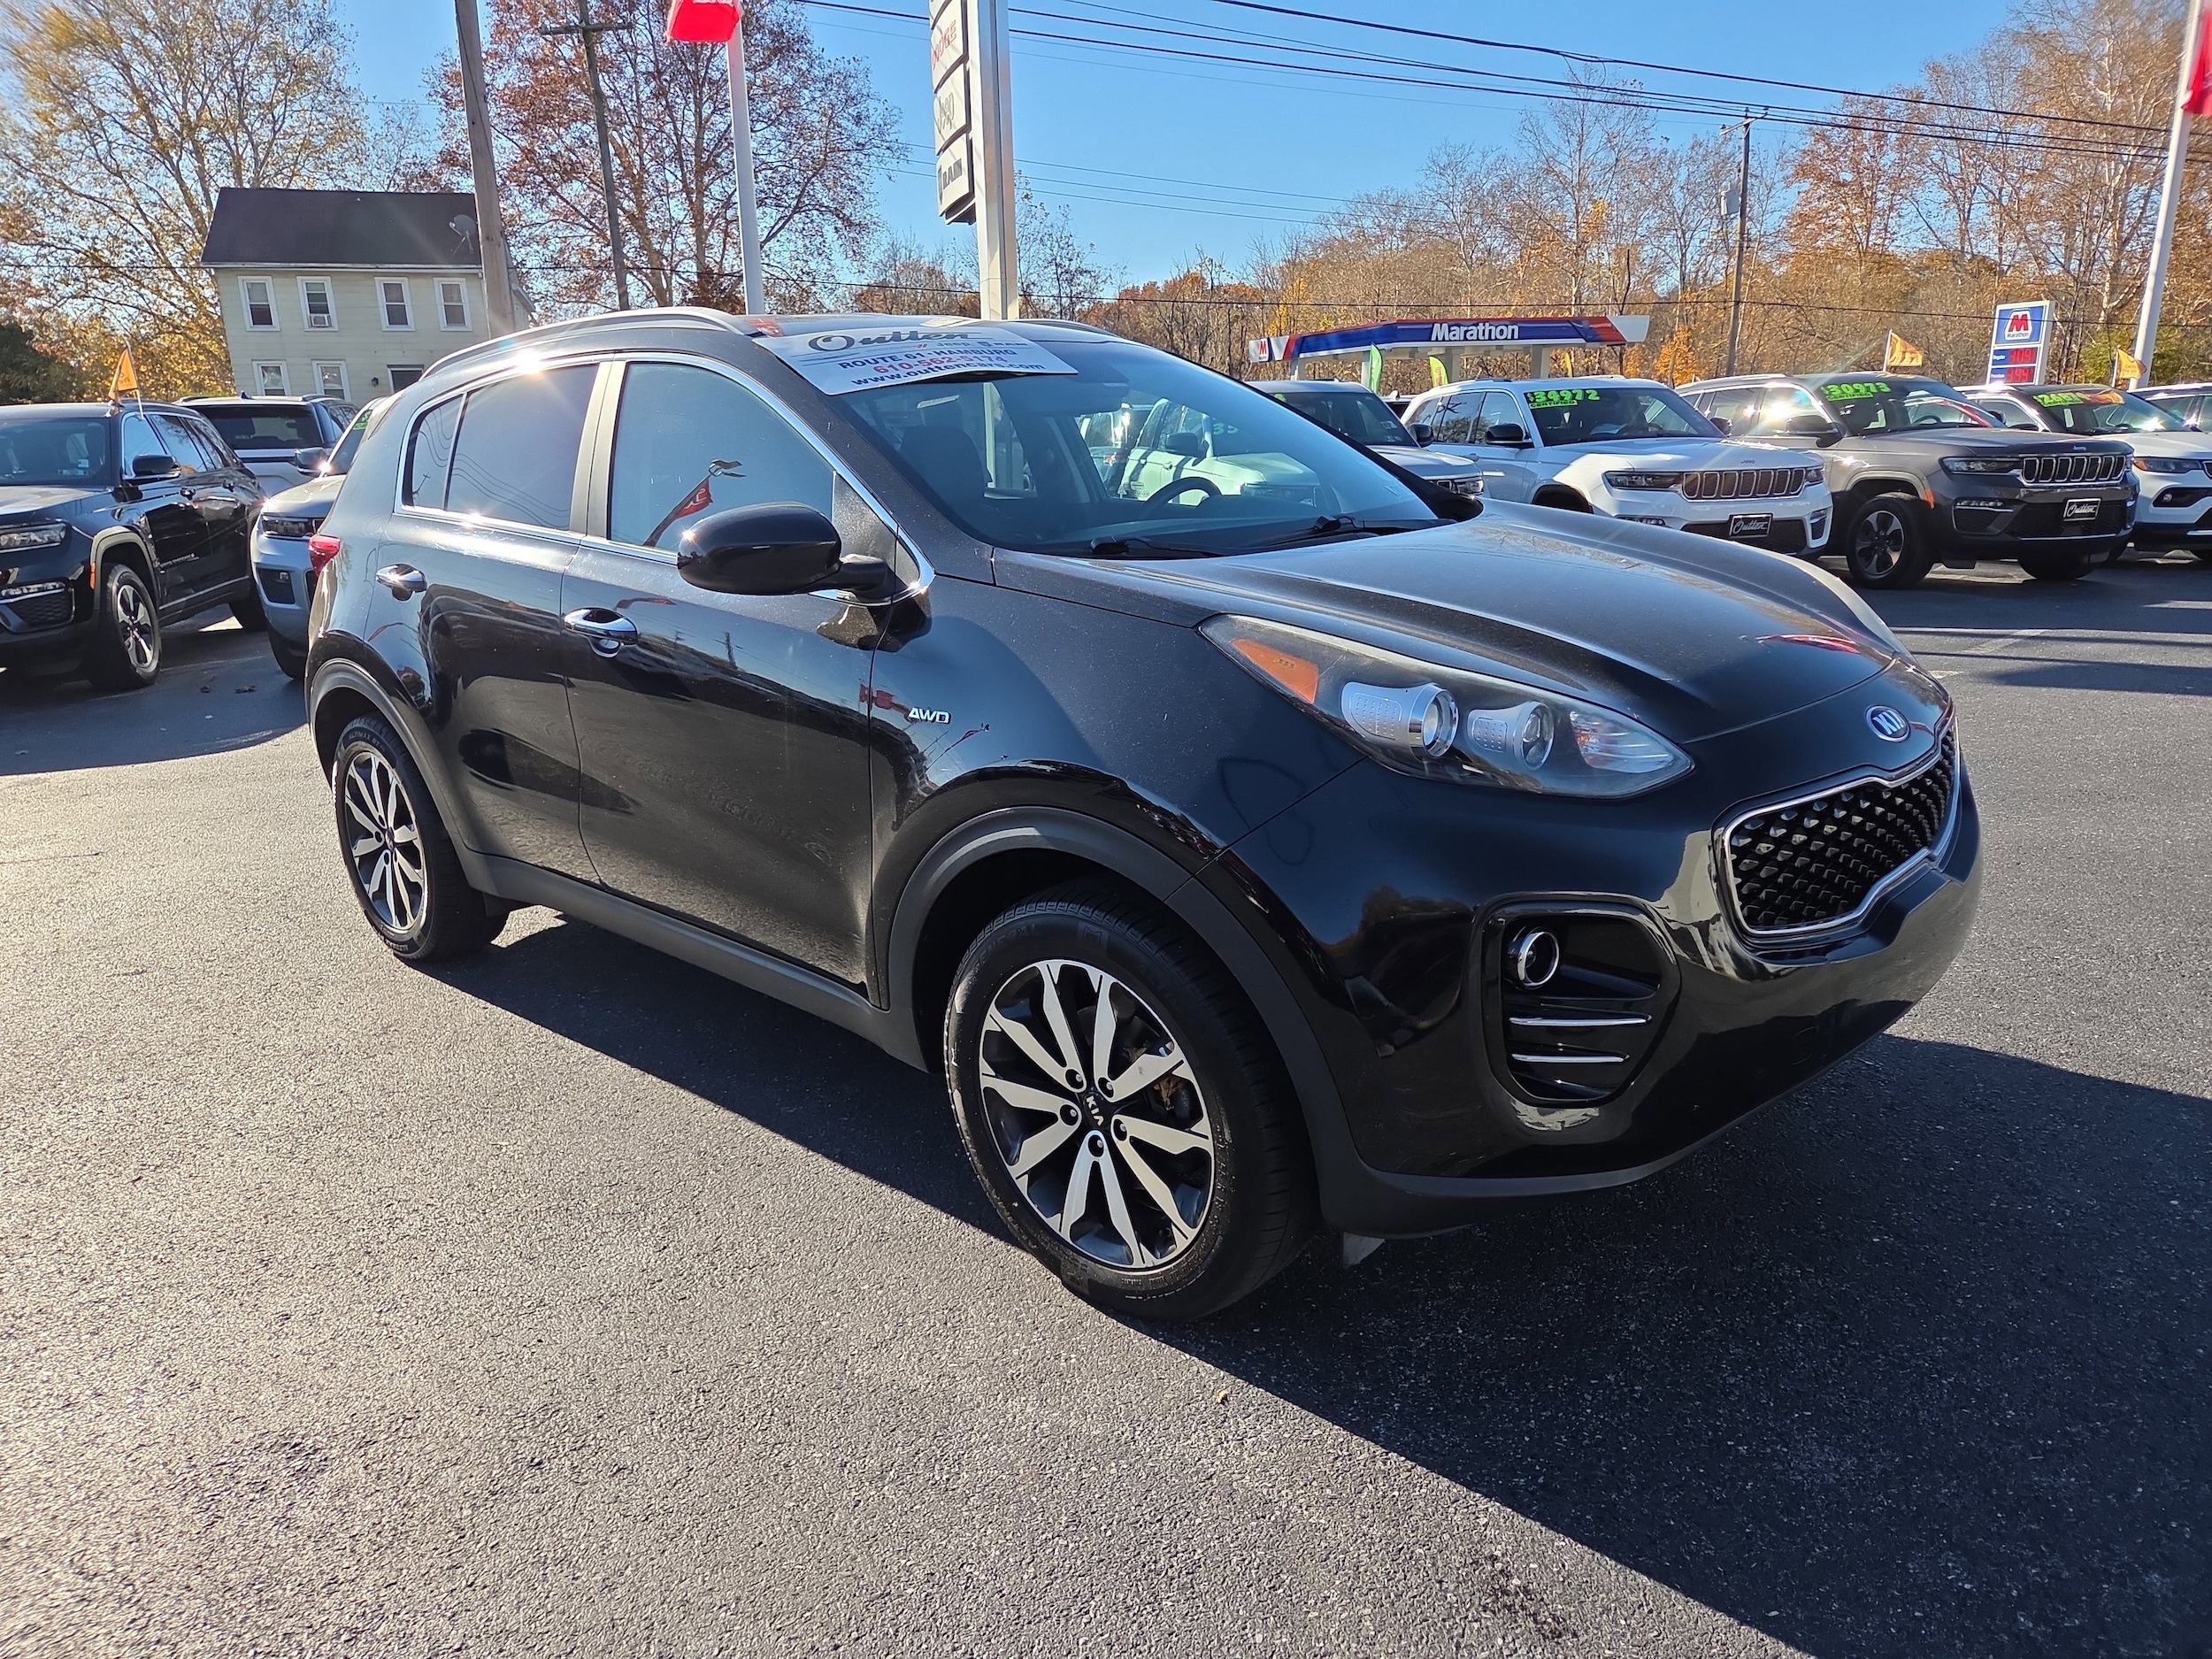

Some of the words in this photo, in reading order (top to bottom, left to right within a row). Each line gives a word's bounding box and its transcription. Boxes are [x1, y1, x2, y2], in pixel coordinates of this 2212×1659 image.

[937, 92, 955, 134] Jeep
[942, 157, 963, 190] RAM
[808, 330, 982, 352] Outten
[1431, 322, 1519, 342] Marathon
[838, 355, 902, 369] ROUTE
[873, 356, 1008, 373] 610-562-5174
[851, 363, 1047, 386] www.outtencars.com
[1732, 519, 1769, 534] Outten
[908, 707, 950, 725] AWD
[1086, 1095, 1104, 1126] KIA
